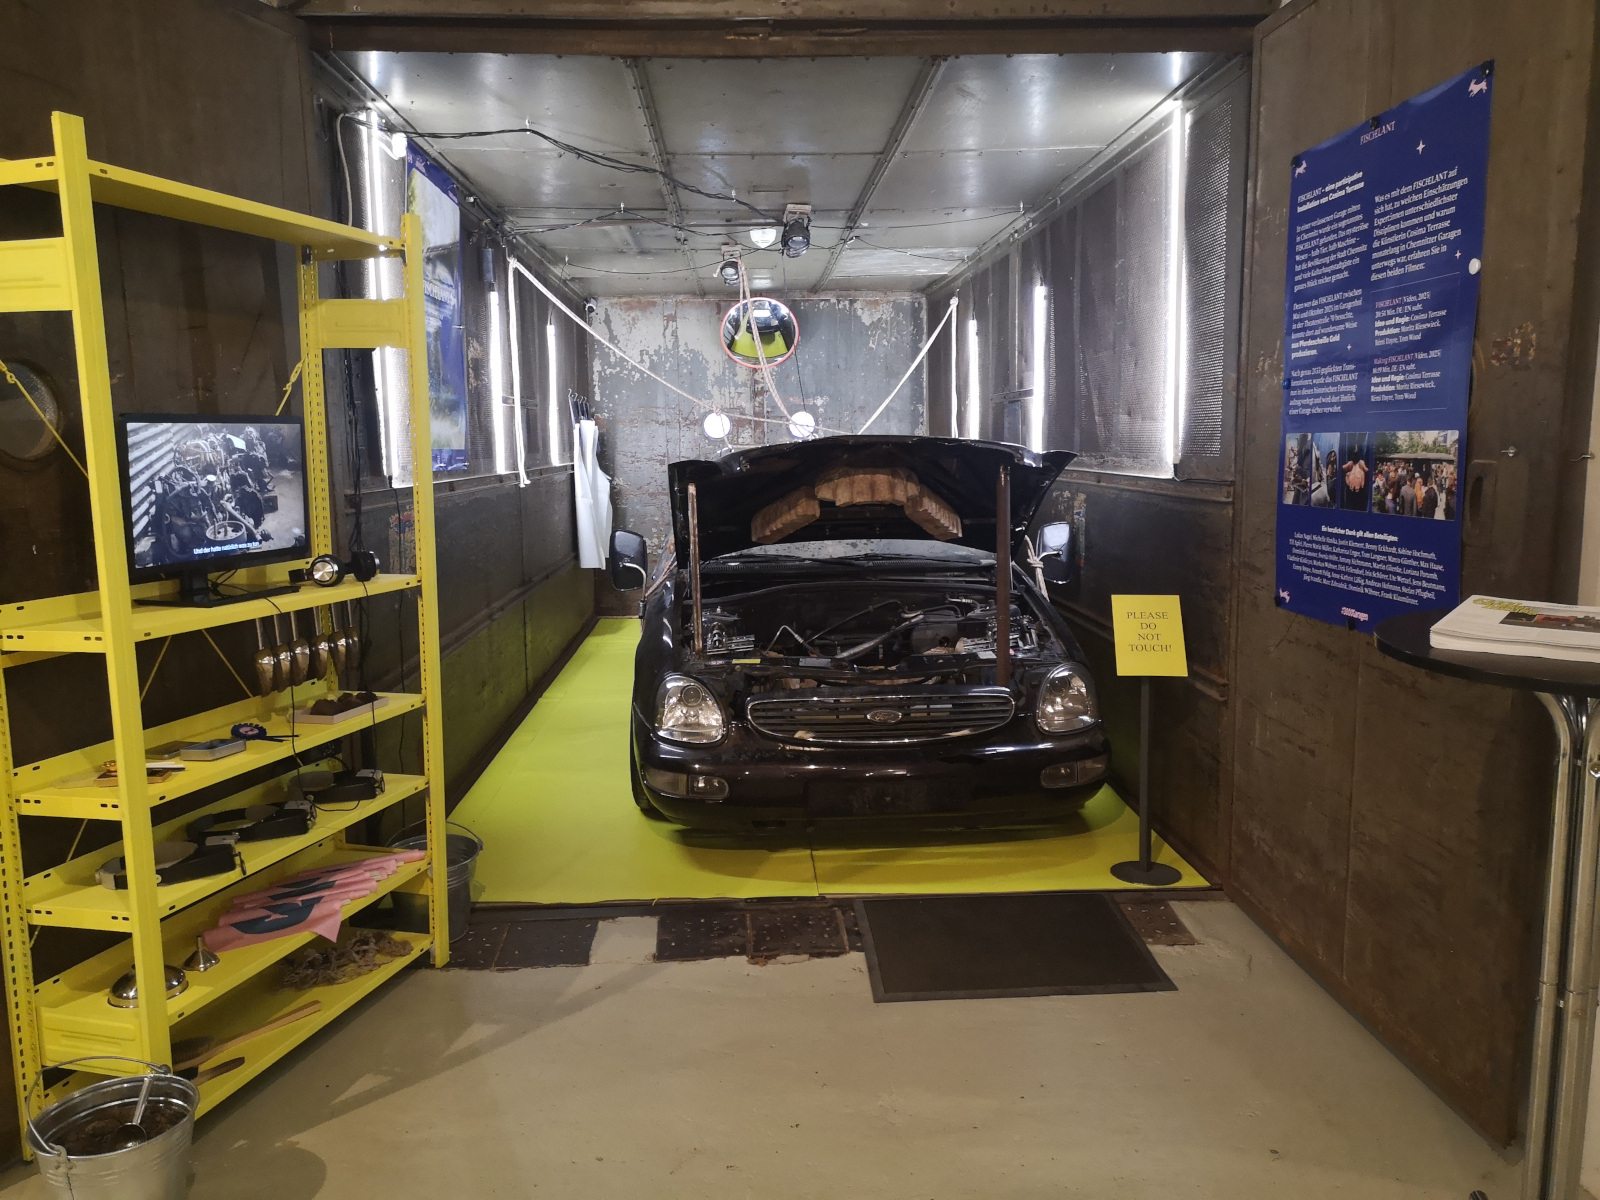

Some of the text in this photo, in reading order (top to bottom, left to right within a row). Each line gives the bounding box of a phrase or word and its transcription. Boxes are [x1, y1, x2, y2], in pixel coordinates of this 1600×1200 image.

[1360, 121, 1396, 145] FISCHELANT
[1413, 171, 1448, 190] FISCHELANT
[1427, 220, 1450, 232] Terrasse
[1438, 229, 1462, 241] Garagen
[1127, 612, 1168, 620] PLEASE
[1129, 644, 1172, 652] TOUCH!
